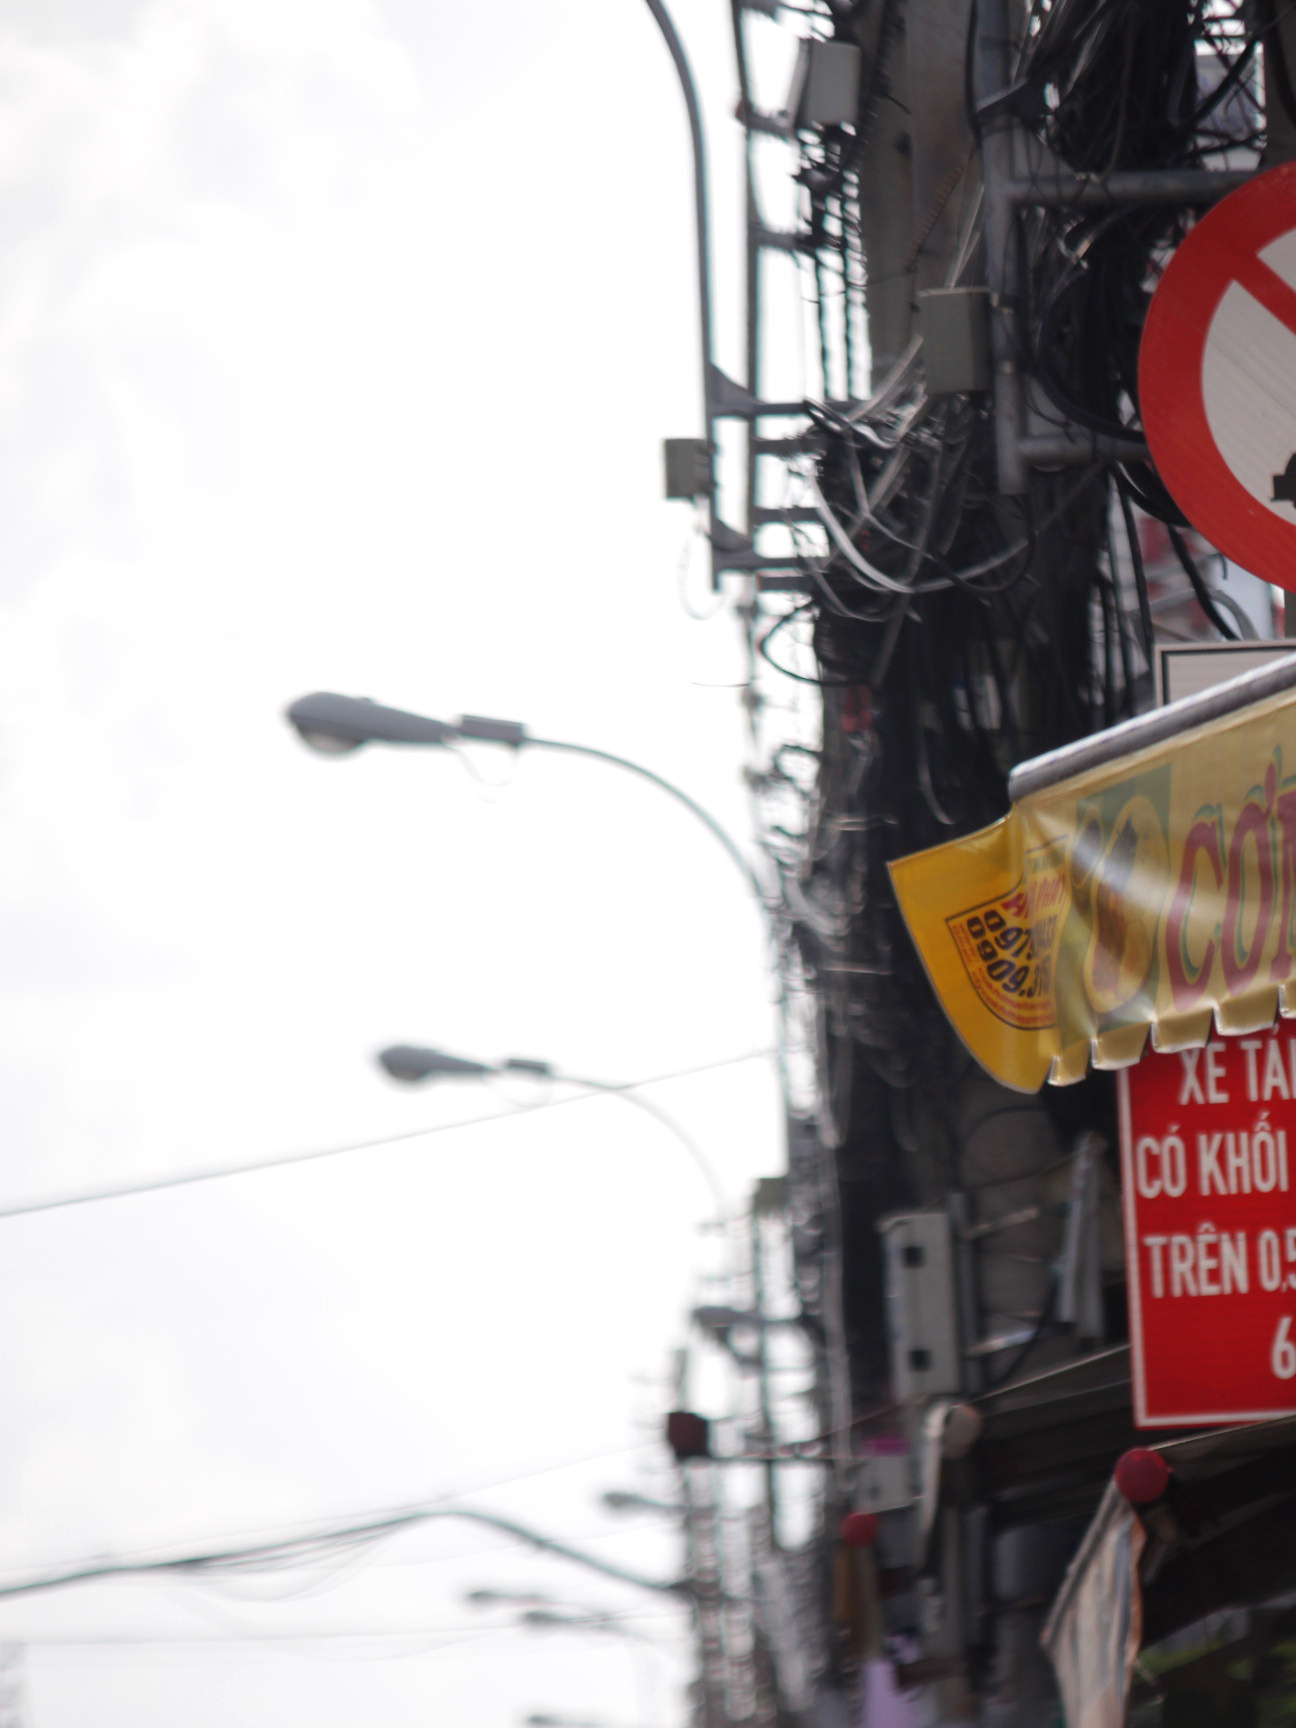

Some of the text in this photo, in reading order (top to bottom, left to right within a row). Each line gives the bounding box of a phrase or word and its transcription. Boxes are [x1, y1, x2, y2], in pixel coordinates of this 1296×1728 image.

[1178, 1040, 1230, 1105] XE
[1136, 1112, 1290, 1200] CÓ KHỐI
[1144, 1223, 1249, 1298] TRÊN
